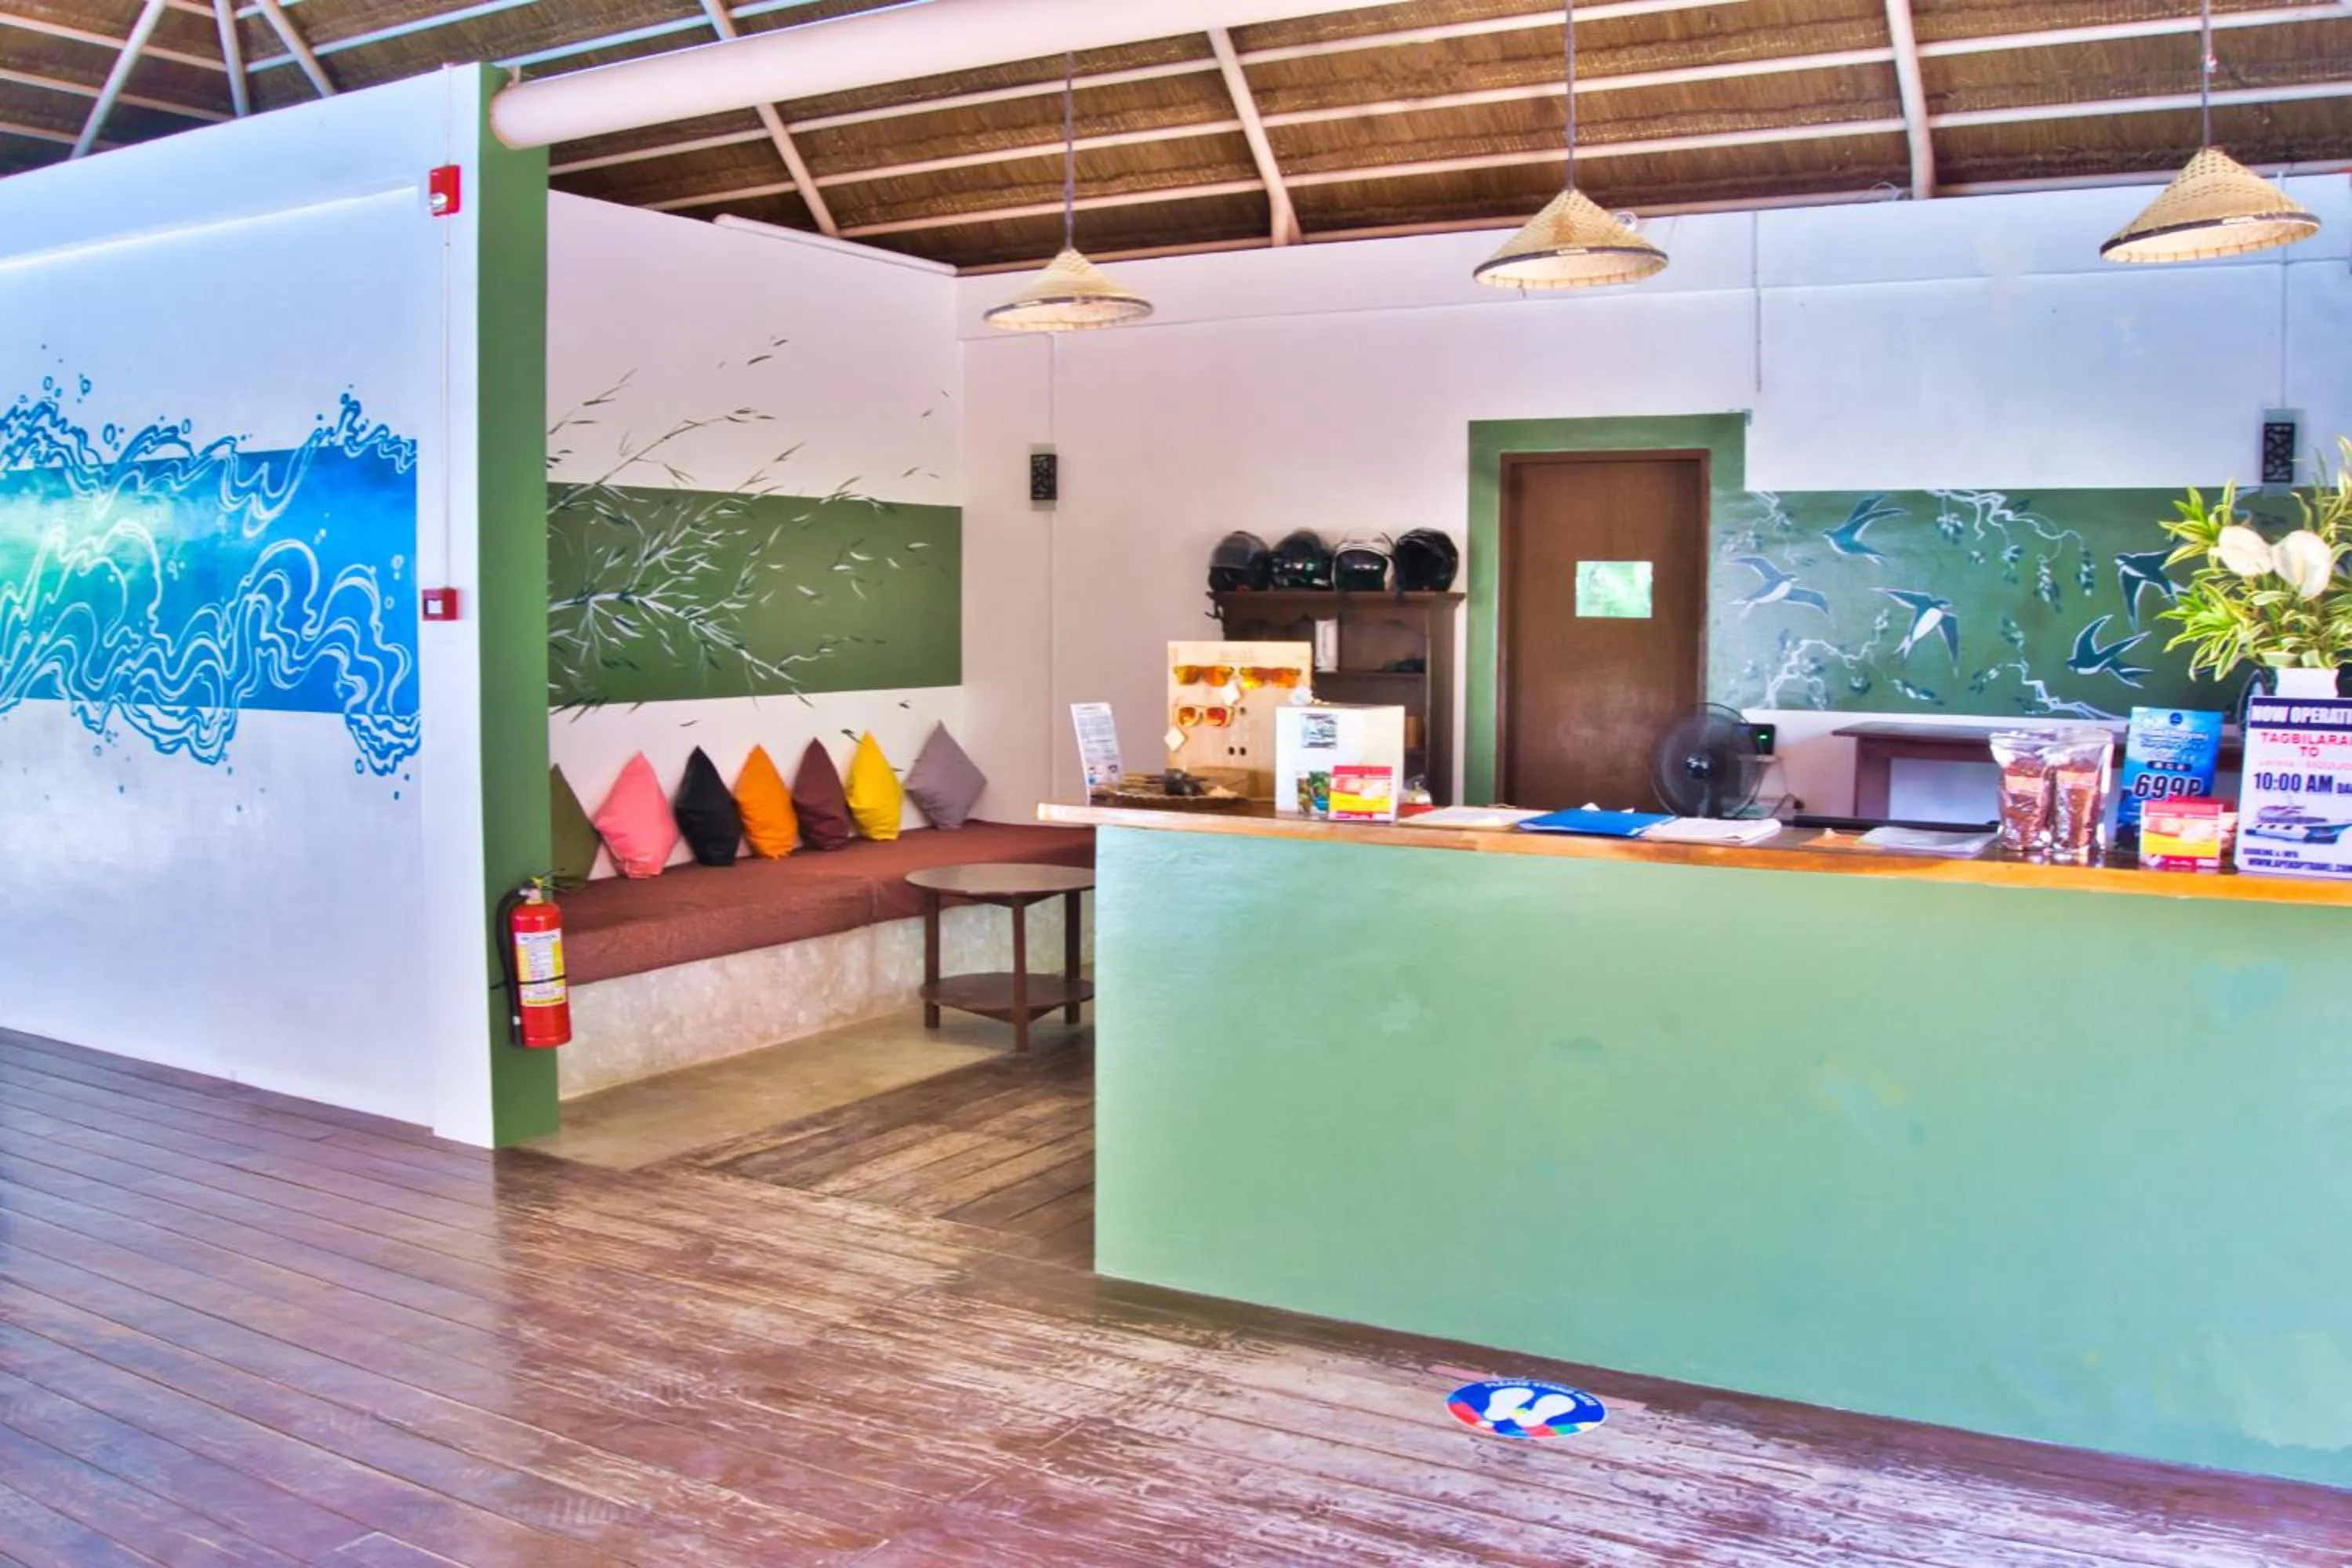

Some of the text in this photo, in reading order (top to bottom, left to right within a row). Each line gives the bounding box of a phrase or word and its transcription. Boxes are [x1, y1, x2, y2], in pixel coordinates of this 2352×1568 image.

[2251, 705, 2288, 721] NOW
[2299, 746, 2319, 757] TO
[2253, 772, 2302, 792] 10:00
[2306, 774, 2333, 793] AM
